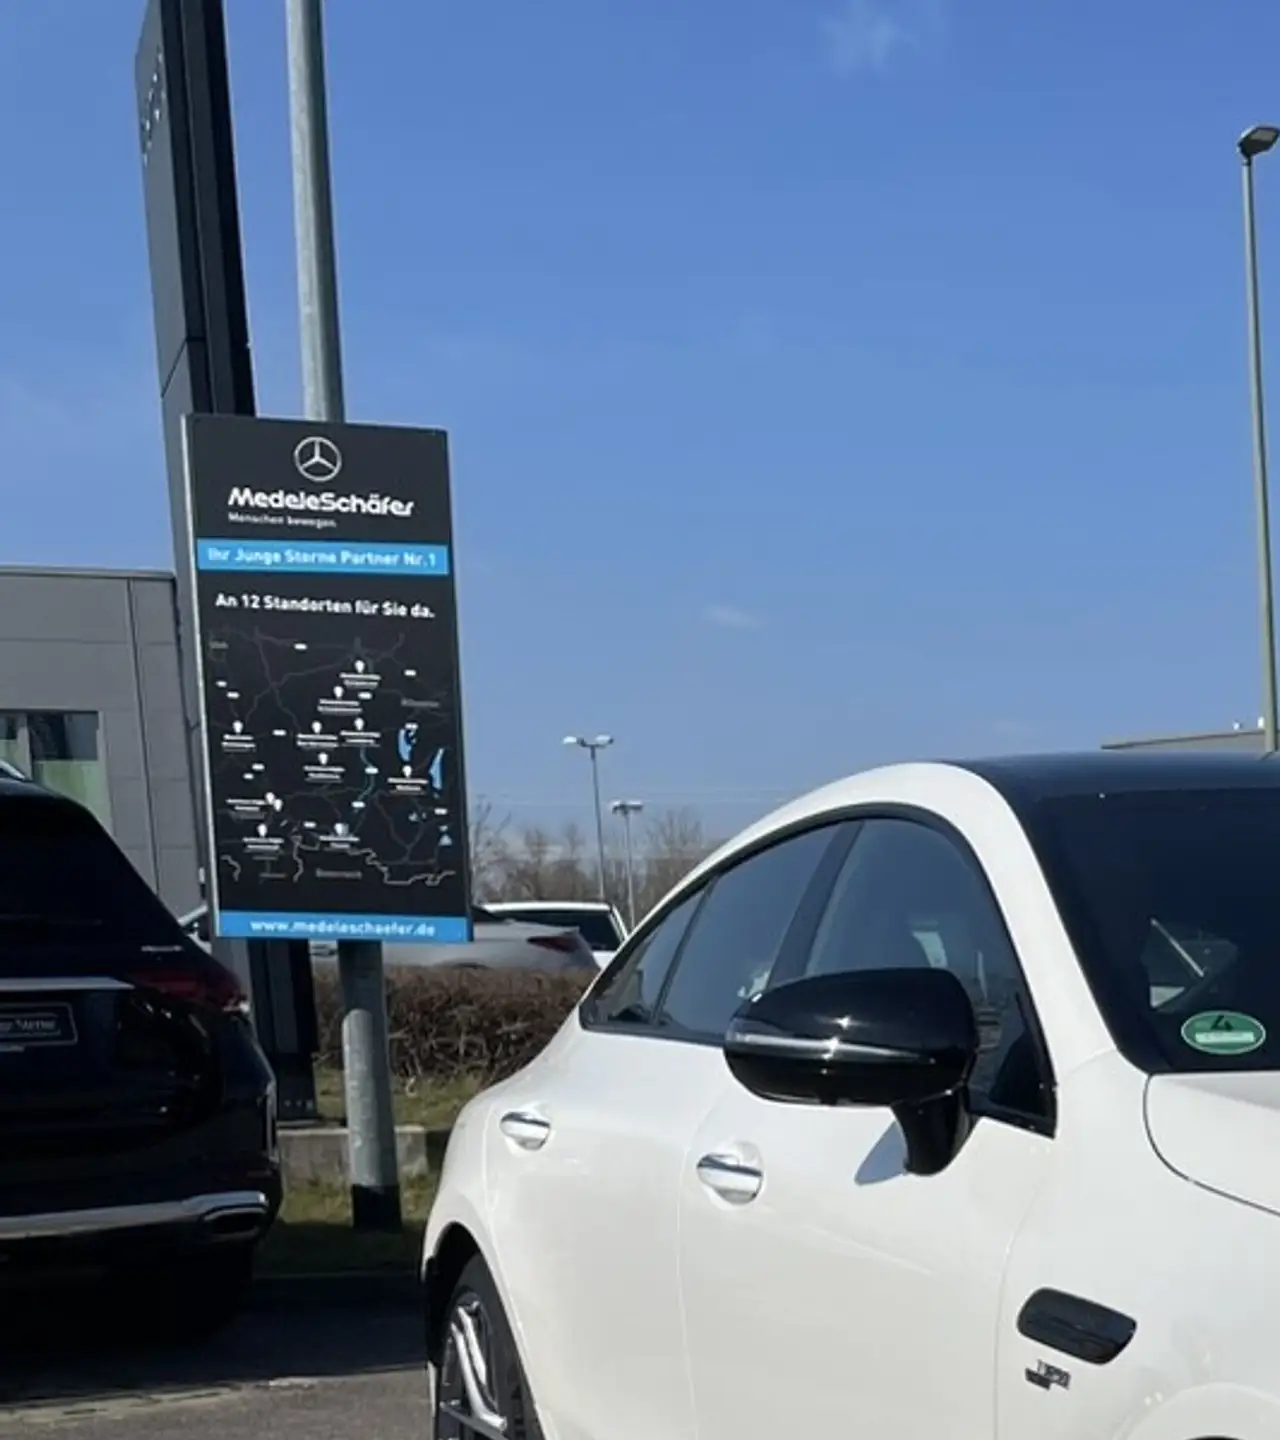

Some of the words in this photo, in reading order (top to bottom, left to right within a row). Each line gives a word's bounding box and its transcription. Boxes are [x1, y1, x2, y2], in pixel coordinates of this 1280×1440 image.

[227, 486, 415, 518] MedeleSchäfer
[207, 547, 230, 562] Ihr
[234, 548, 281, 566] Junge
[286, 549, 338, 564] Sterne
[340, 550, 399, 566] Partner
[215, 592, 239, 608] An
[240, 594, 261, 610] 12
[262, 594, 352, 614] Standorten
[355, 596, 379, 616] für
[381, 600, 408, 618] Sie
[409, 602, 436, 619] da.
